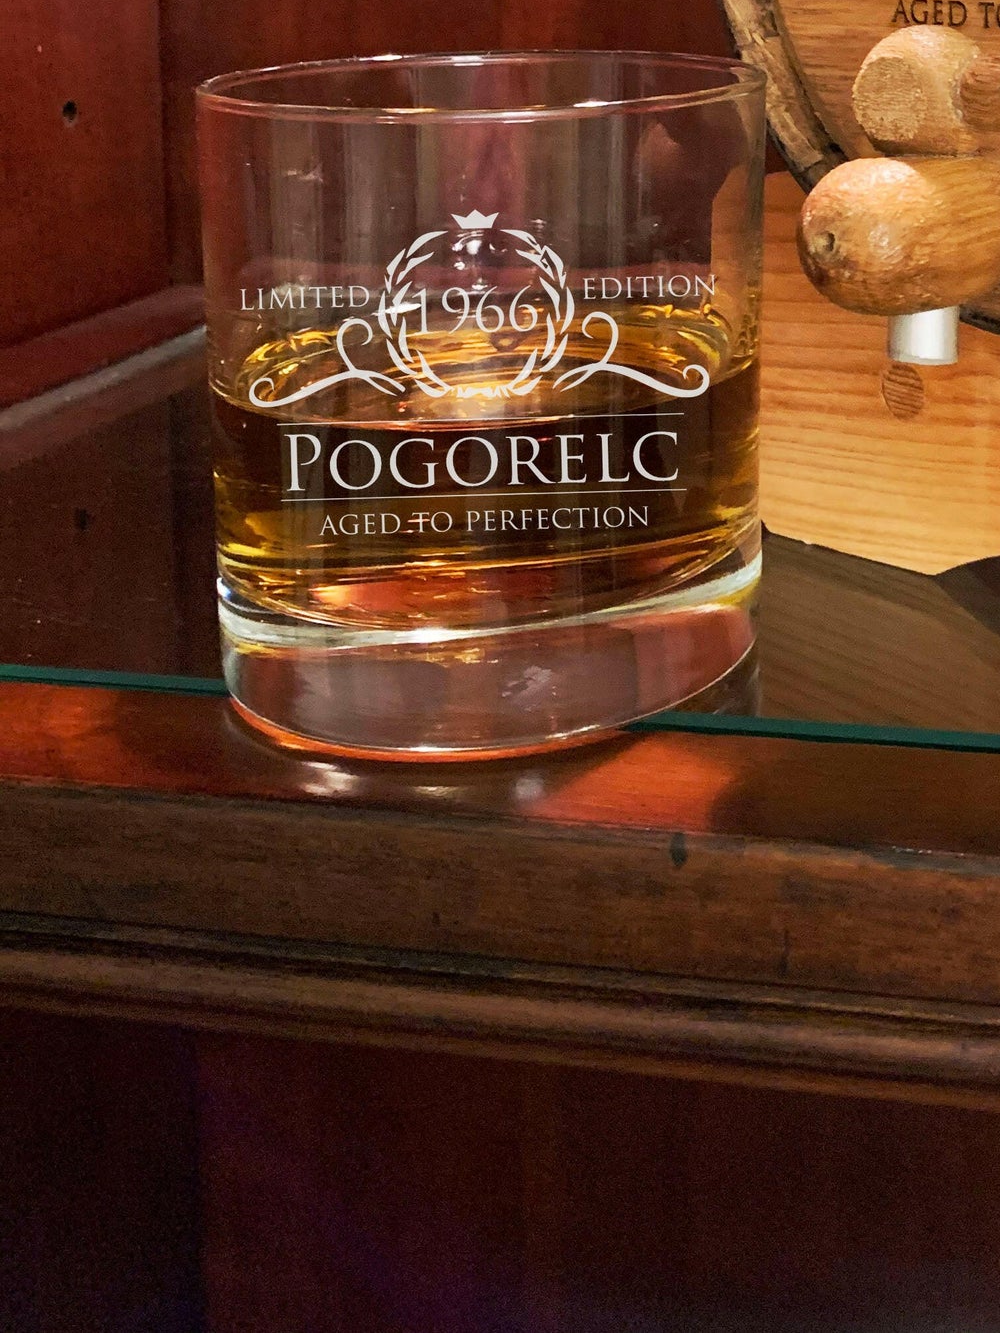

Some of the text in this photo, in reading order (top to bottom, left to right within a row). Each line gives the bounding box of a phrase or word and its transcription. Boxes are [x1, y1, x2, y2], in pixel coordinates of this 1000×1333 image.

[240, 273, 717, 336] LIMITED 1966 EDITION
[284, 431, 679, 493] POGORELC
[319, 505, 650, 536] AGED TO PERFECTION
